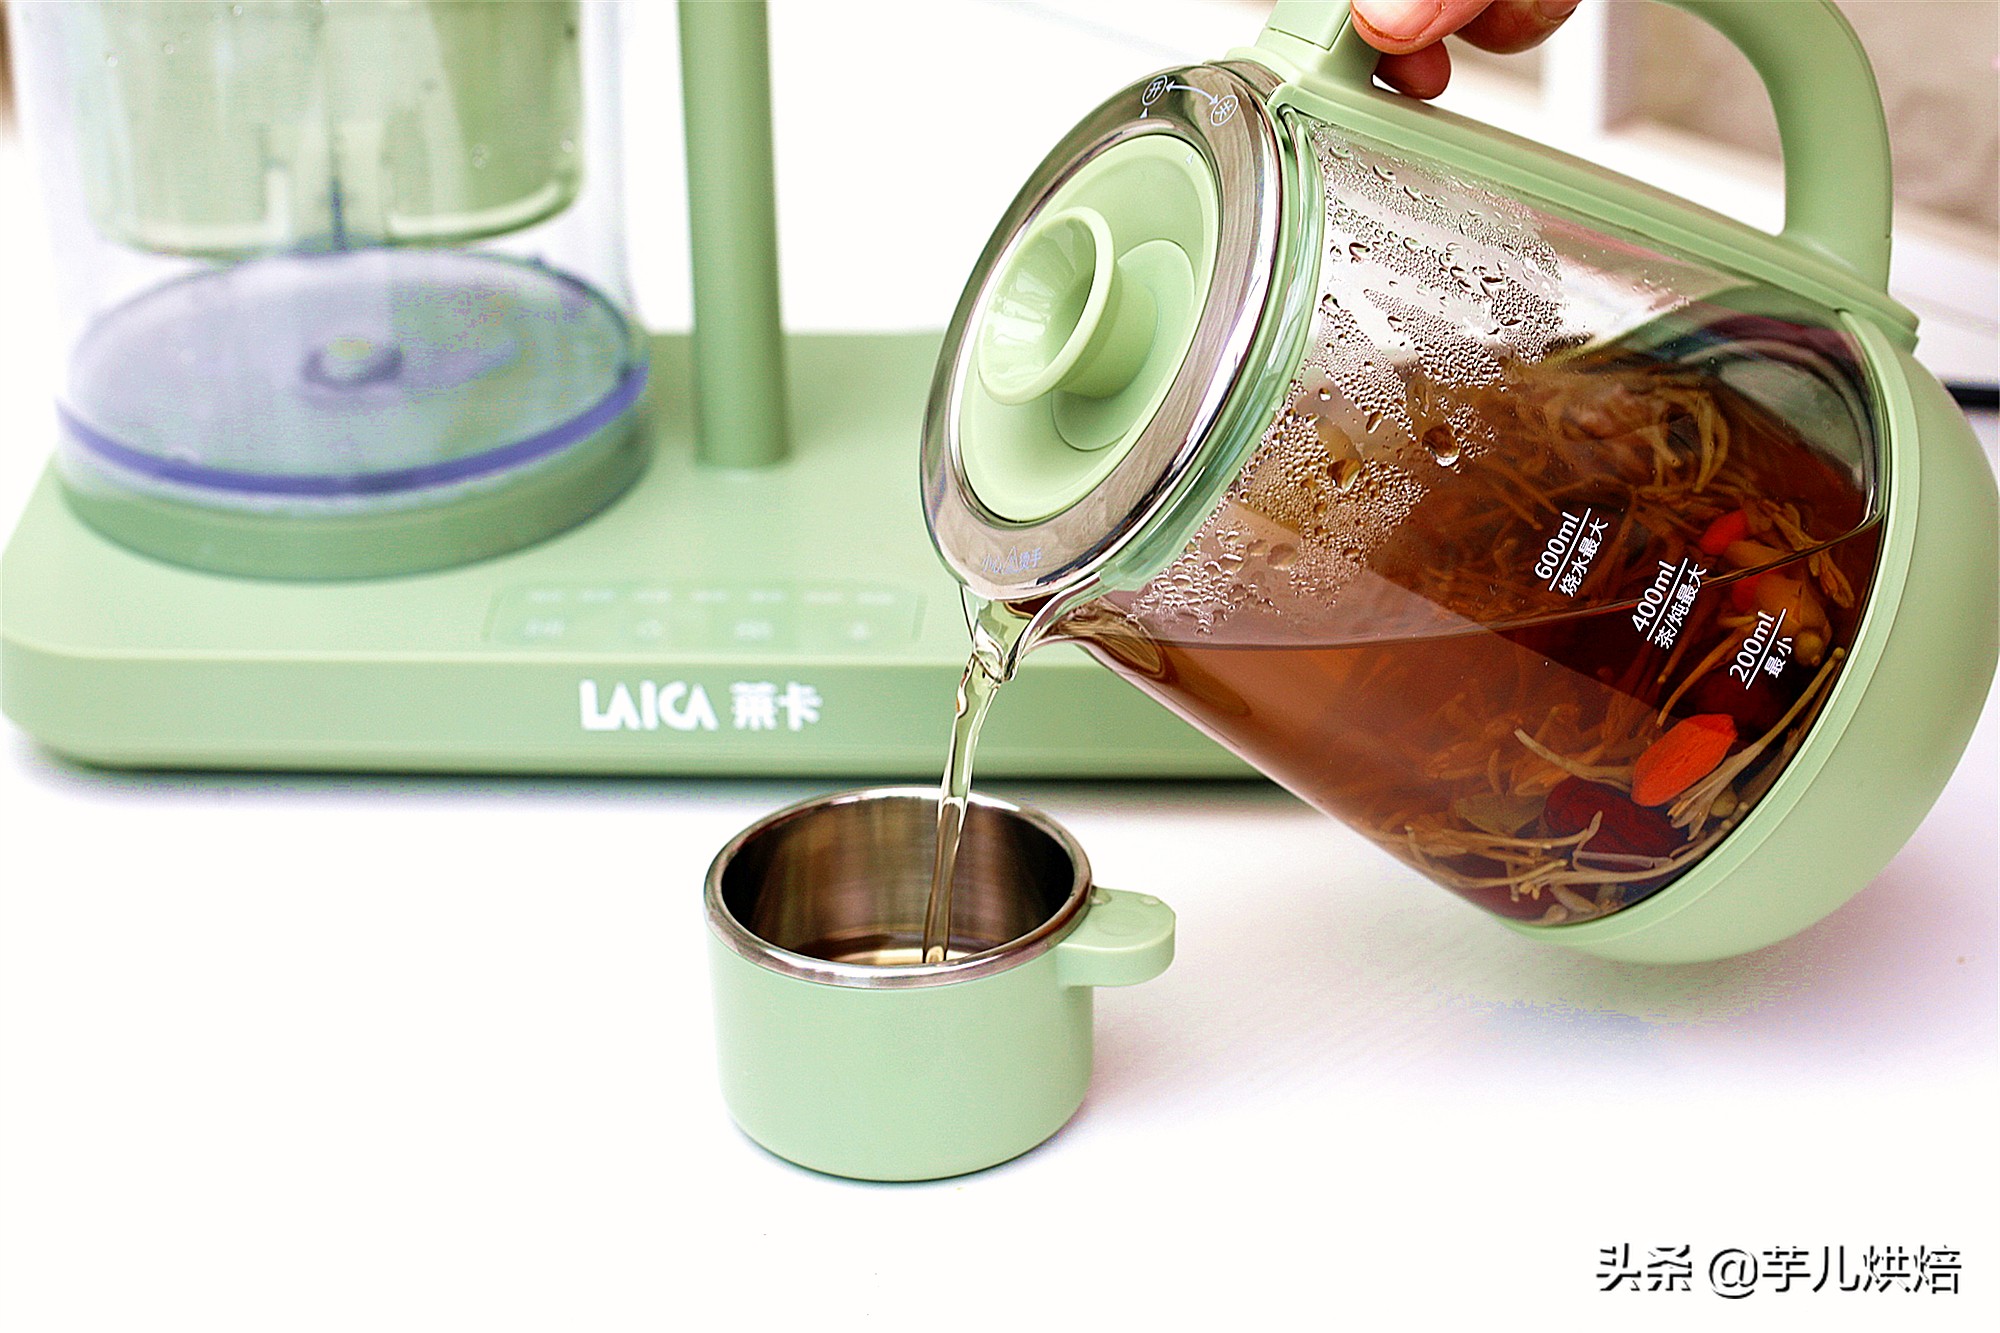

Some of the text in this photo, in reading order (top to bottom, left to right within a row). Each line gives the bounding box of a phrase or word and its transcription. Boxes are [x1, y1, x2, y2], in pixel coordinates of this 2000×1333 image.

[1146, 80, 1164, 100] 开
[1215, 100, 1233, 121] 关
[1534, 511, 1580, 580] 600ml
[1558, 517, 1609, 597] 烧水最大
[1631, 560, 1677, 633] 400ml
[1654, 563, 1707, 650] 茶/炖最大
[1729, 610, 1775, 683] 200ml
[1763, 635, 1793, 679] 最小
[579, 680, 823, 731] LAICA 莱卡
